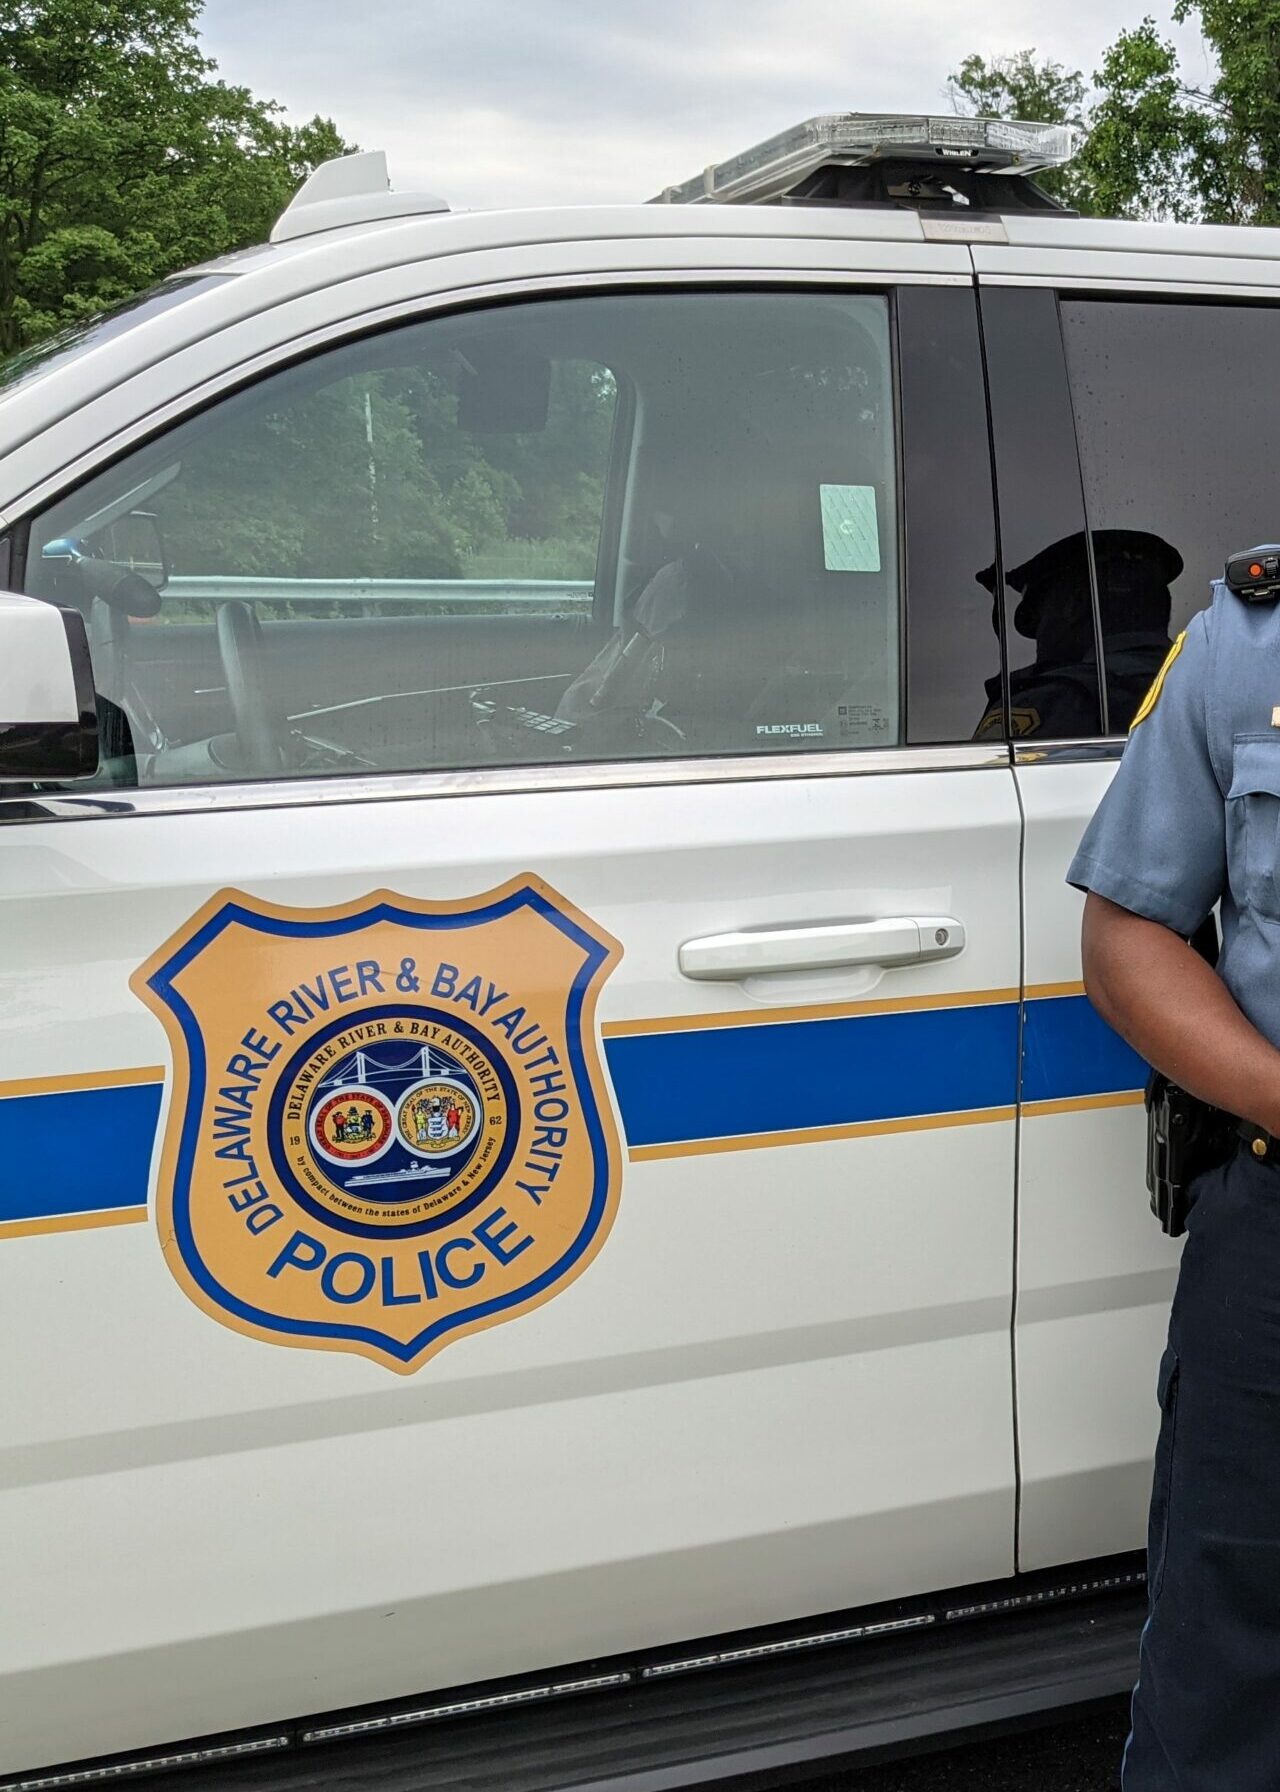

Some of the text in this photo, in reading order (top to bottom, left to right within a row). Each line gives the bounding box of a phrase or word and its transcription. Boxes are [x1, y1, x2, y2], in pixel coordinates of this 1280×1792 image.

[942, 148, 972, 157] WHELEN
[756, 723, 824, 734] FLEXFUEL
[287, 1021, 502, 1121] DELAWARE RIVER & BAY AUTHORITY
[212, 957, 570, 1236] DELAWARE RIVER & BAY AUTHORITY
[416, 1090, 423, 1098] OF
[439, 1086, 458, 1096] STATE
[489, 1115, 502, 1126] 62
[289, 1135, 301, 1146] 19
[296, 1136, 497, 1217] by compact between the states of Delaware & New Jersey
[266, 1206, 535, 1307] POLICE
